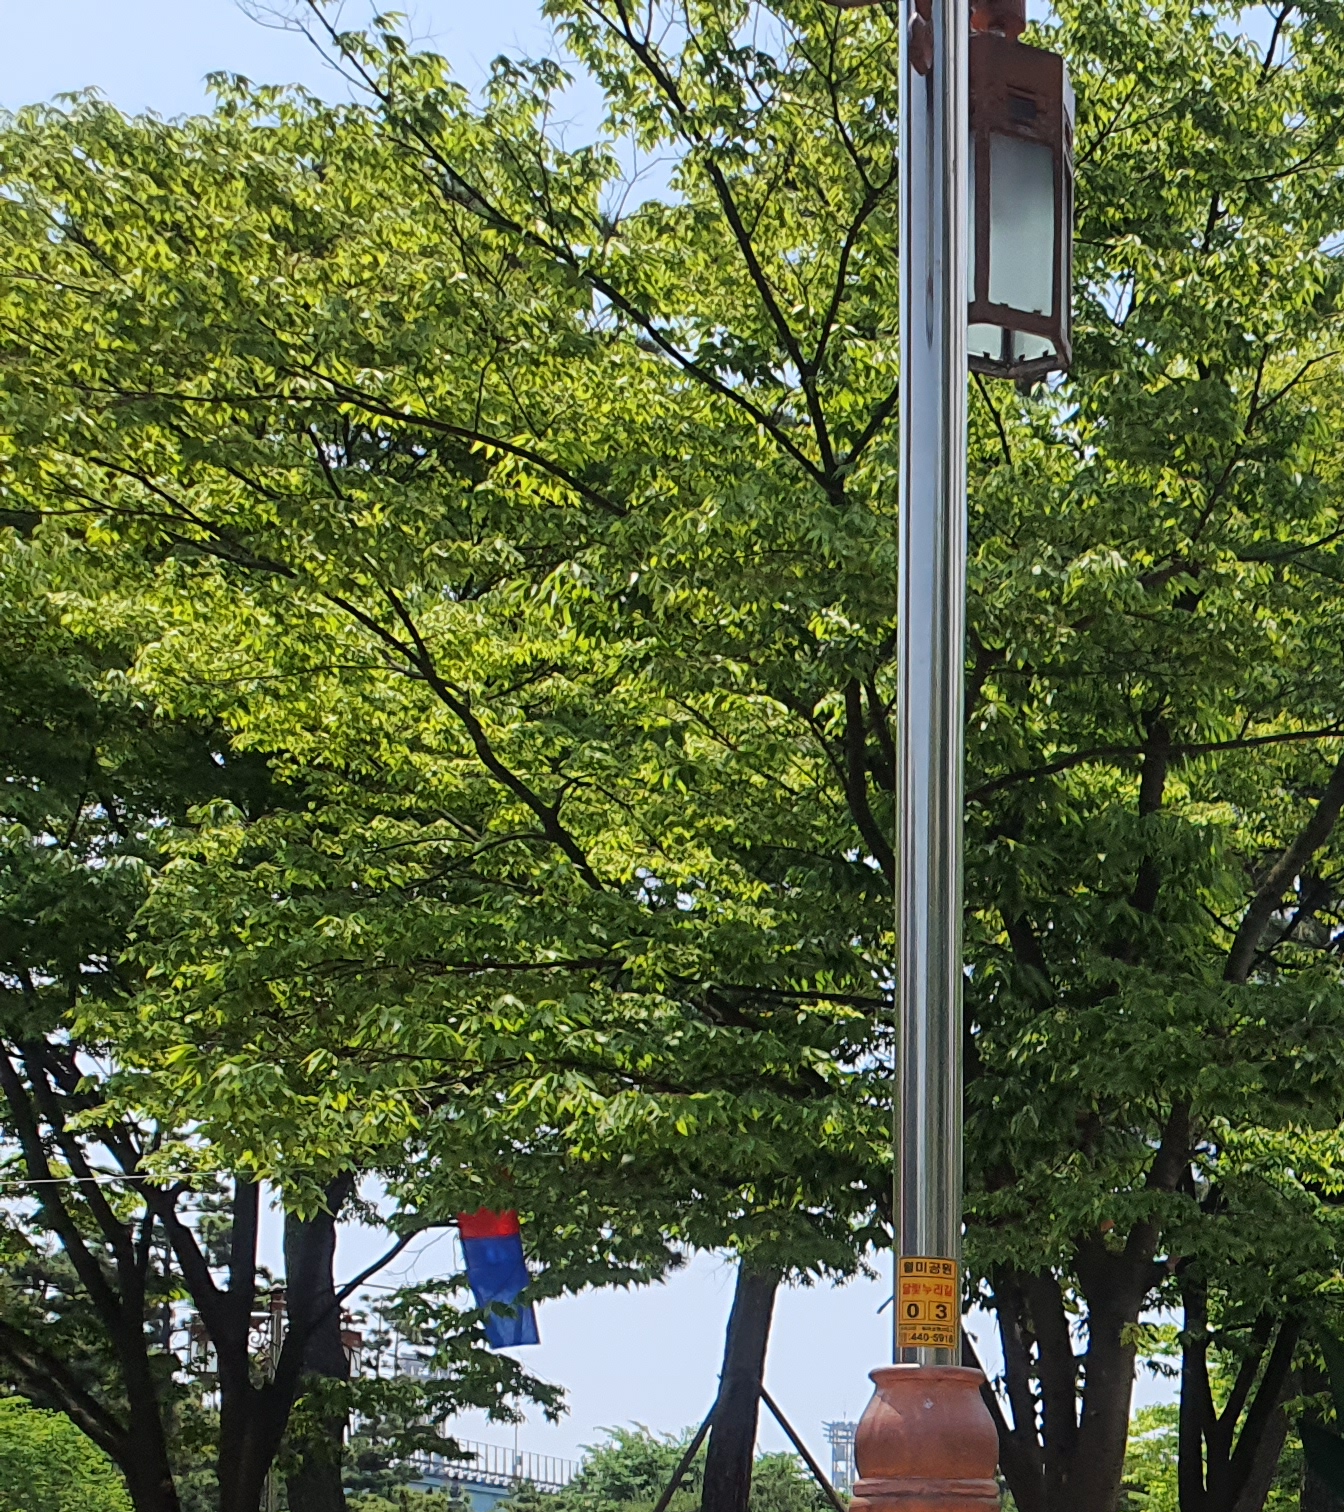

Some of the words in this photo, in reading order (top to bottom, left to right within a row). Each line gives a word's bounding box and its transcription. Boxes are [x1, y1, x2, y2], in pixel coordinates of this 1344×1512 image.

[904, 1262, 952, 1275] 월미공원
[907, 1303, 919, 1318] 0
[935, 1304, 947, 1319] 3
